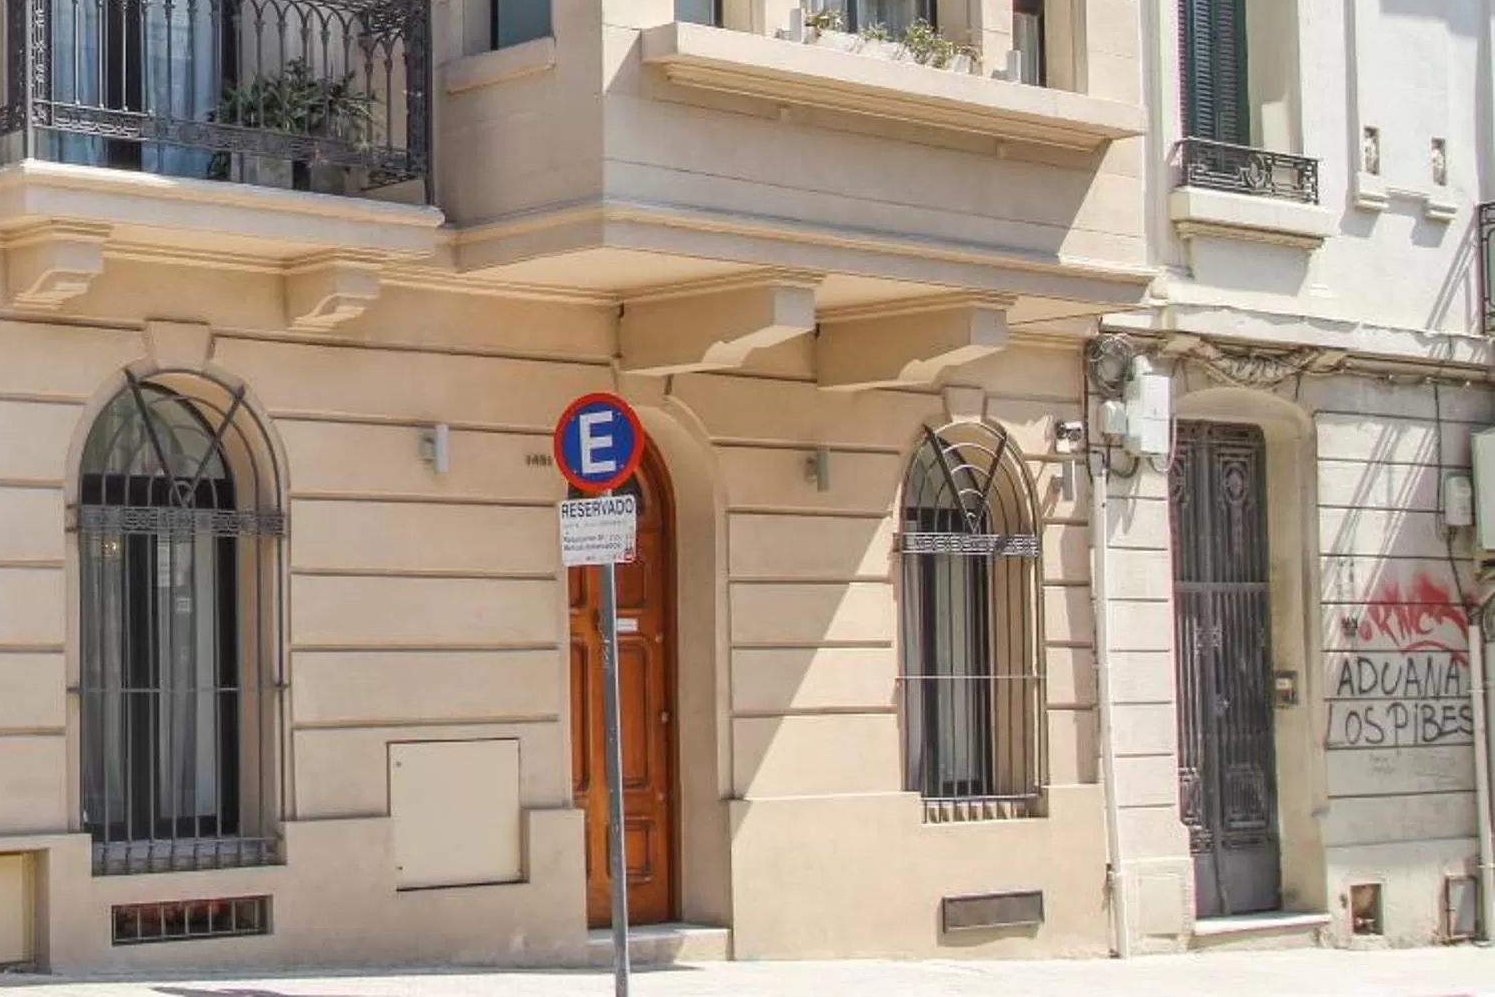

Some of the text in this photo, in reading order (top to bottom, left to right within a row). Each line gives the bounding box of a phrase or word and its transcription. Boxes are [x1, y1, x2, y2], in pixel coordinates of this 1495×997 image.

[579, 411, 617, 475] E
[561, 498, 634, 519] RESERVADO
[1337, 657, 1461, 699] ADUANA
[1323, 704, 1385, 746] LOS
